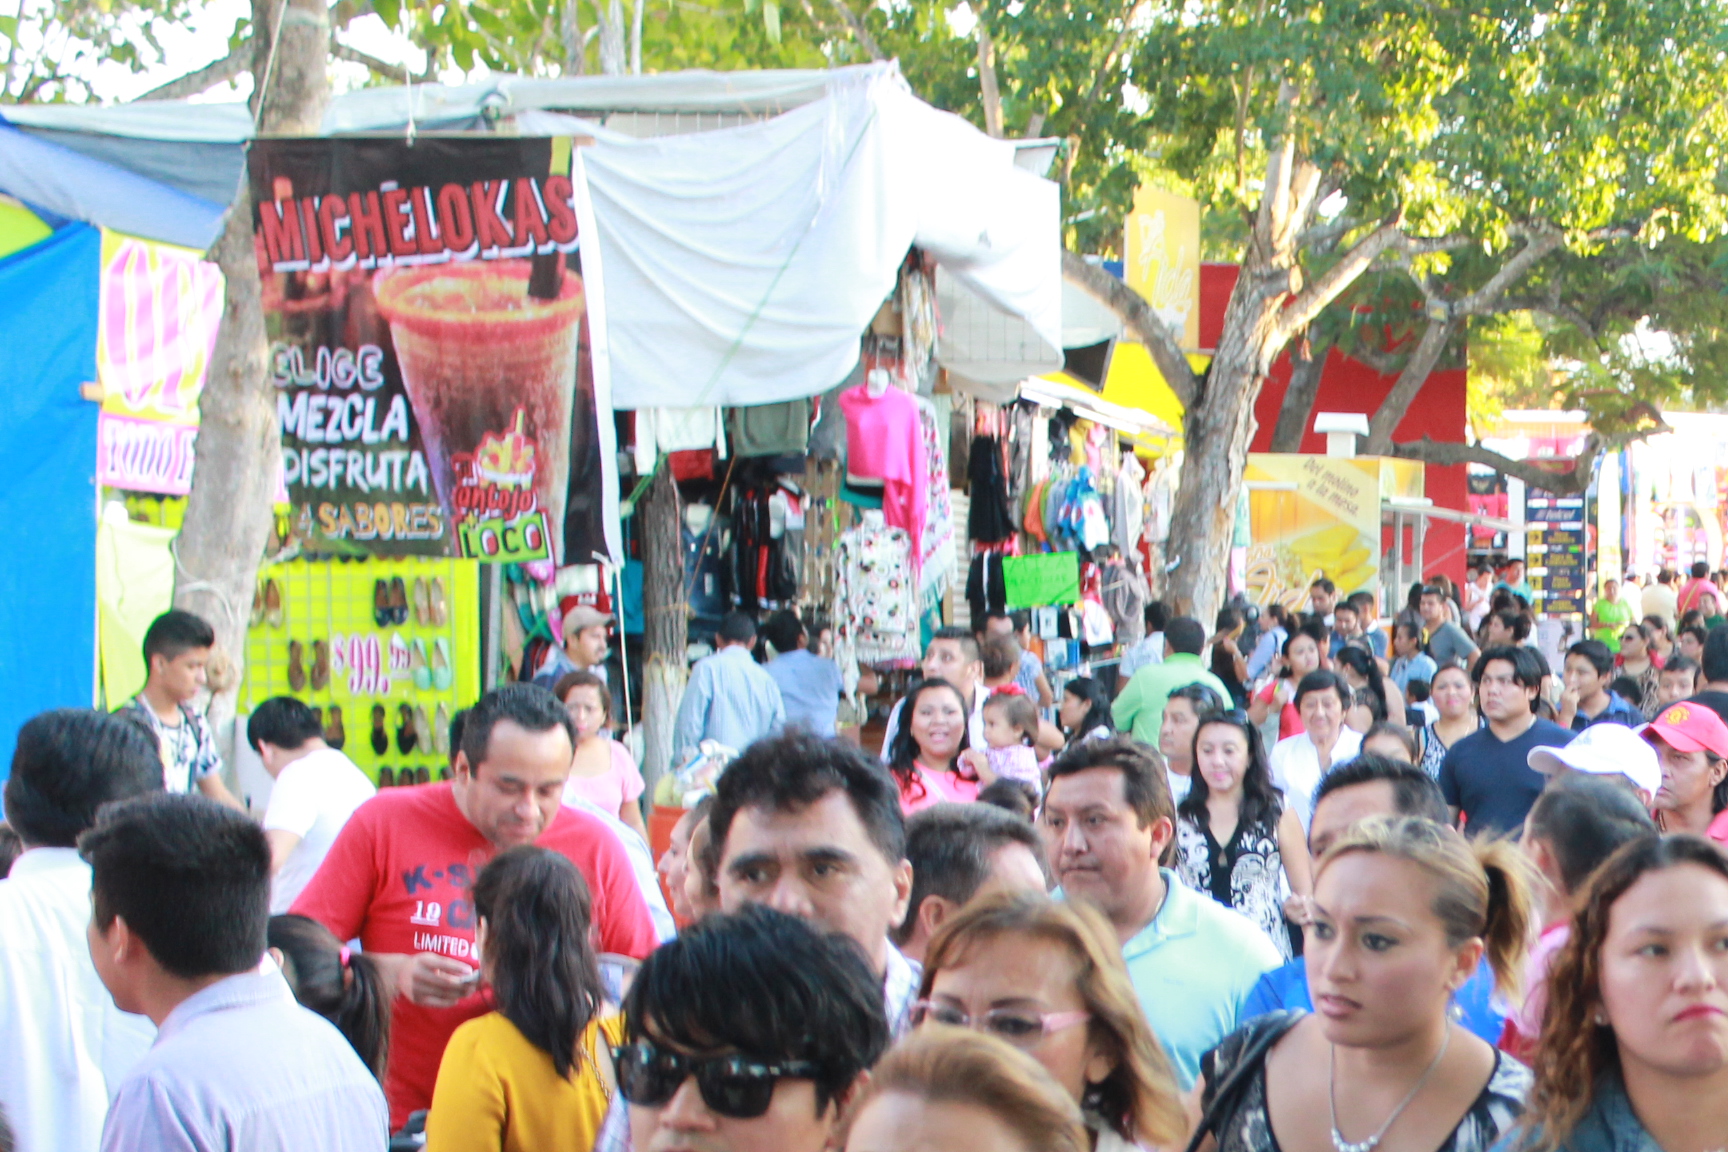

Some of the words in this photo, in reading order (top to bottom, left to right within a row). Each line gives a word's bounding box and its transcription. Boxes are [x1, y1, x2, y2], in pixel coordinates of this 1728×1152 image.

[258, 174, 580, 272] MICHELOKAS
[271, 340, 384, 391] ELIGE
[277, 390, 409, 445] MEZCLA
[282, 446, 429, 497] DISFRUTA
[1322, 469, 1360, 496] molino
[318, 501, 444, 541] SABORES
[461, 521, 543, 561] LOCO
[413, 931, 470, 958] LIMITED
